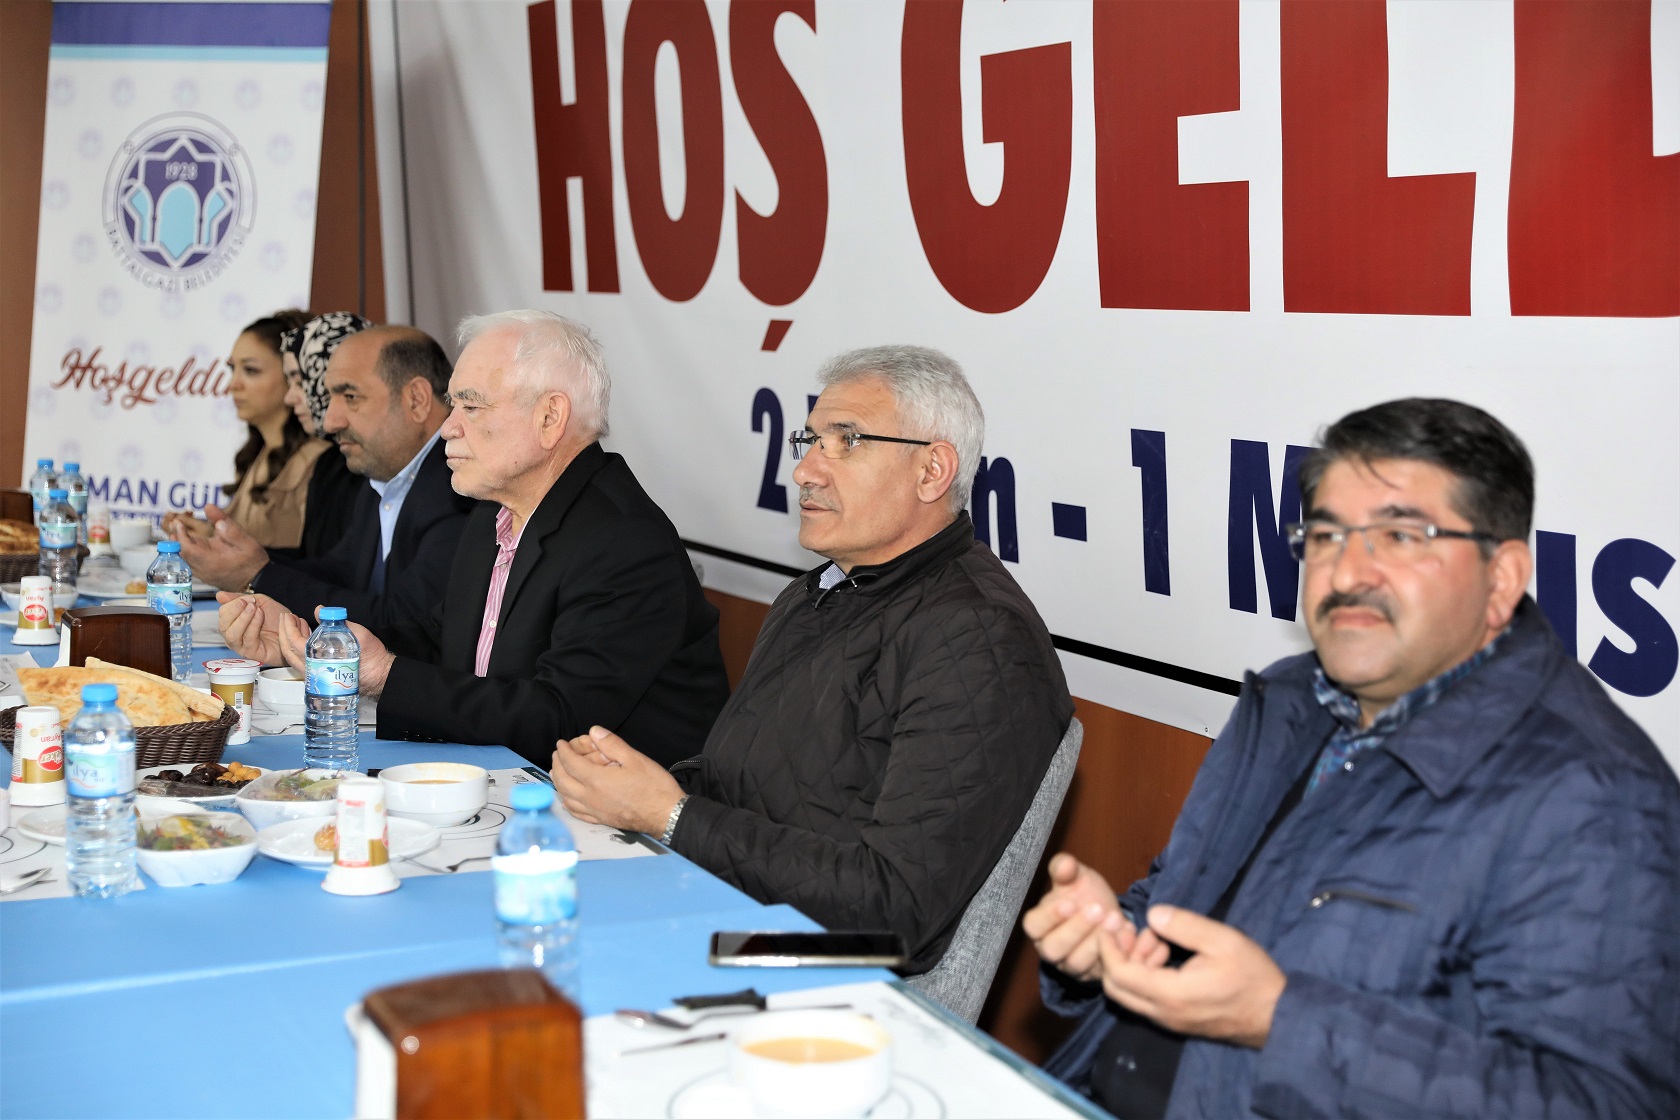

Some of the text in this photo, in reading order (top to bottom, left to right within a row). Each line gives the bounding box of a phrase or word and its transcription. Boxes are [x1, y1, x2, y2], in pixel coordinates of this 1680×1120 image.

[165, 161, 199, 181] 1928
[527, 0, 829, 351] HOŞ
[50, 346, 232, 410] Hoşgeldi
[1130, 428, 1171, 597] 1
